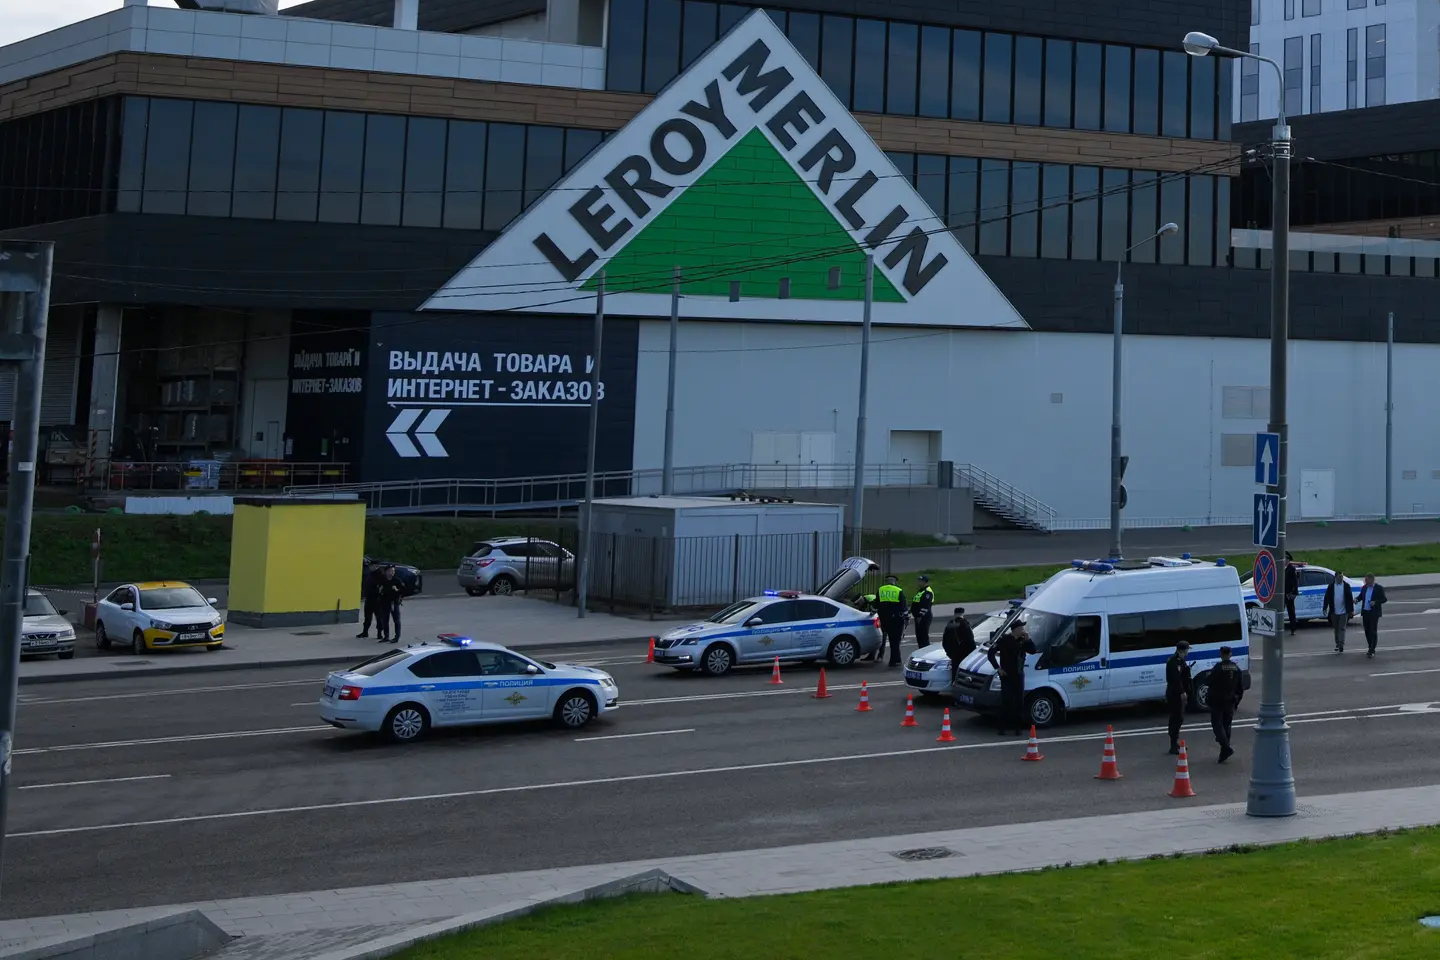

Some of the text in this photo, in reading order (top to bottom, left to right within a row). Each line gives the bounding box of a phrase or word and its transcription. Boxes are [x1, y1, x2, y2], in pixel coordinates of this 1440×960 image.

[532, 38, 948, 297] LEROY MERLIN
[389, 350, 482, 375] ВЫДАЧА
[493, 352, 573, 374] ТОВАРА
[880, 590, 897, 599] ДПС
[1062, 664, 1096, 673] ПОЛИЦИЯ
[499, 679, 534, 688] ПОЛИЦИЯ
